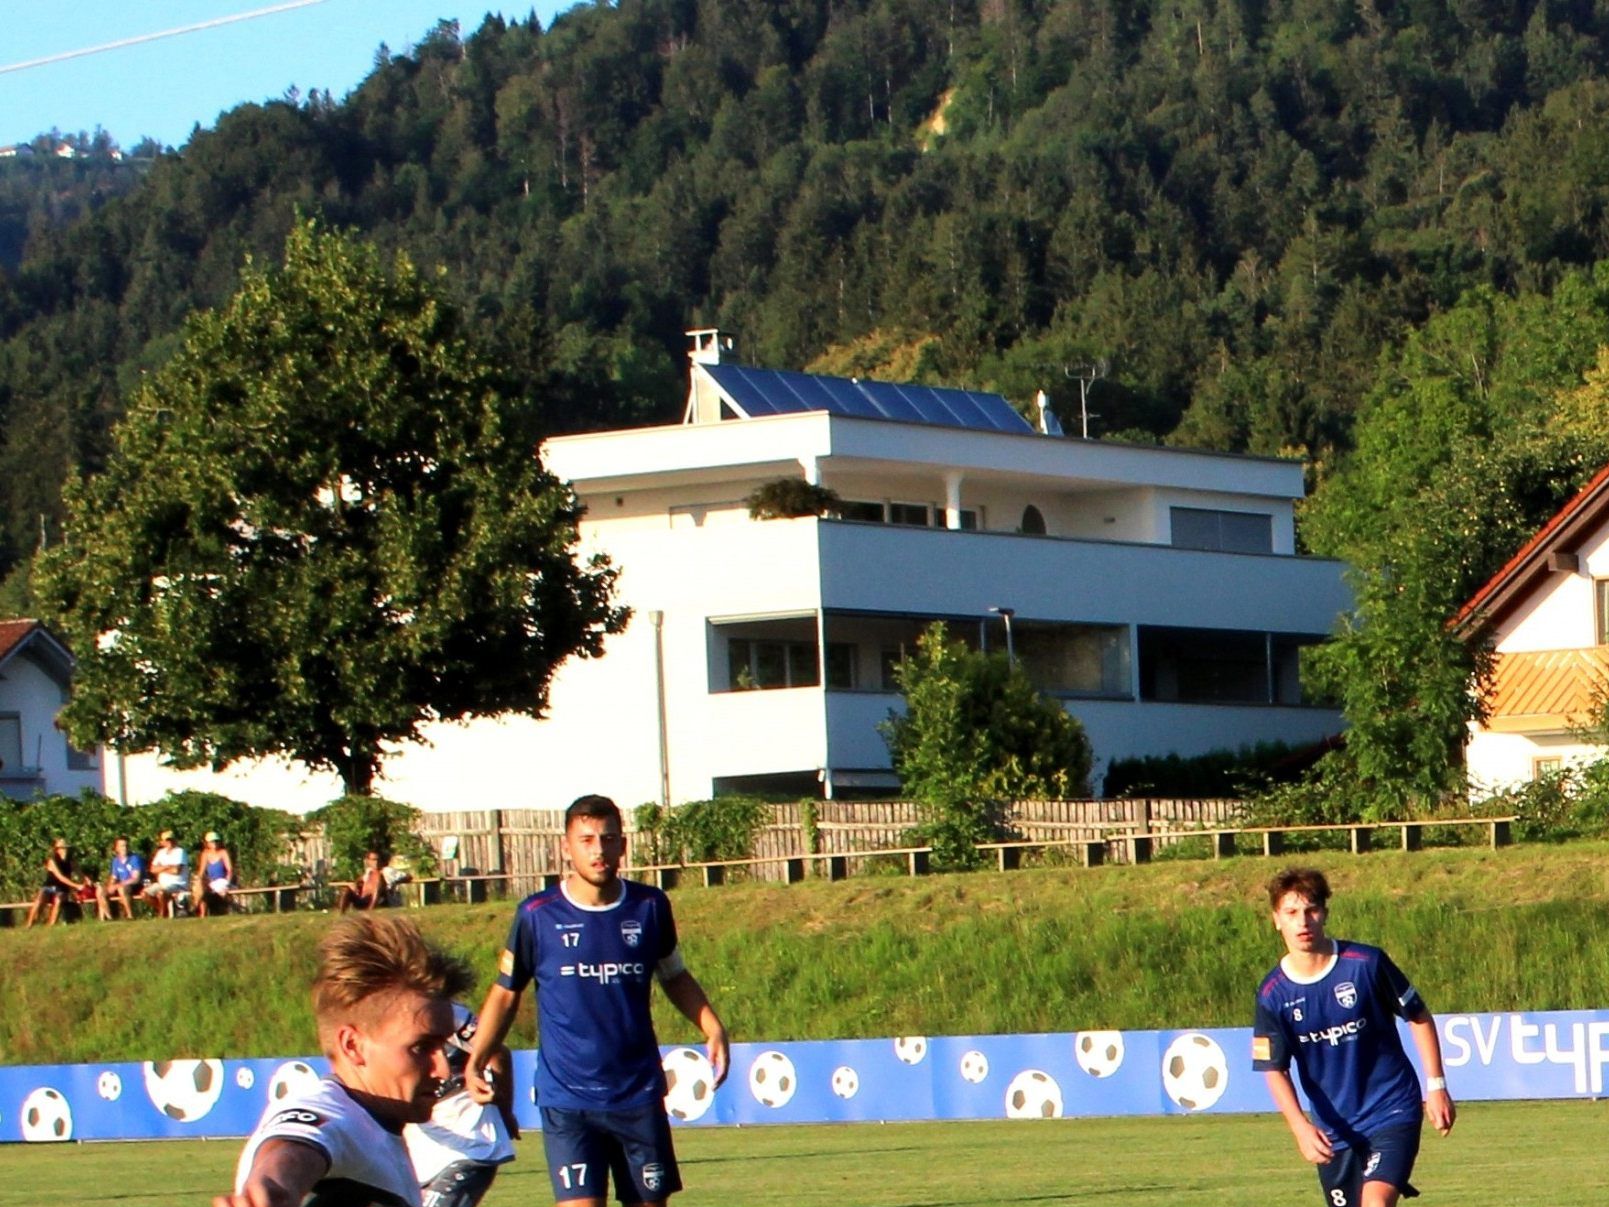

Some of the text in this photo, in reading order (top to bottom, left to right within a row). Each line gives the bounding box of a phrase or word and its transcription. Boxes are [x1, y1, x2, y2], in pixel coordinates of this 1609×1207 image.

[562, 932, 580, 948] 17
[578, 962, 645, 985] typico
[1293, 1007, 1304, 1022] 8
[1309, 1017, 1367, 1046] typico
[1444, 1016, 1501, 1067] SV
[559, 1162, 587, 1189] 17
[1330, 1188, 1347, 1207] 8
